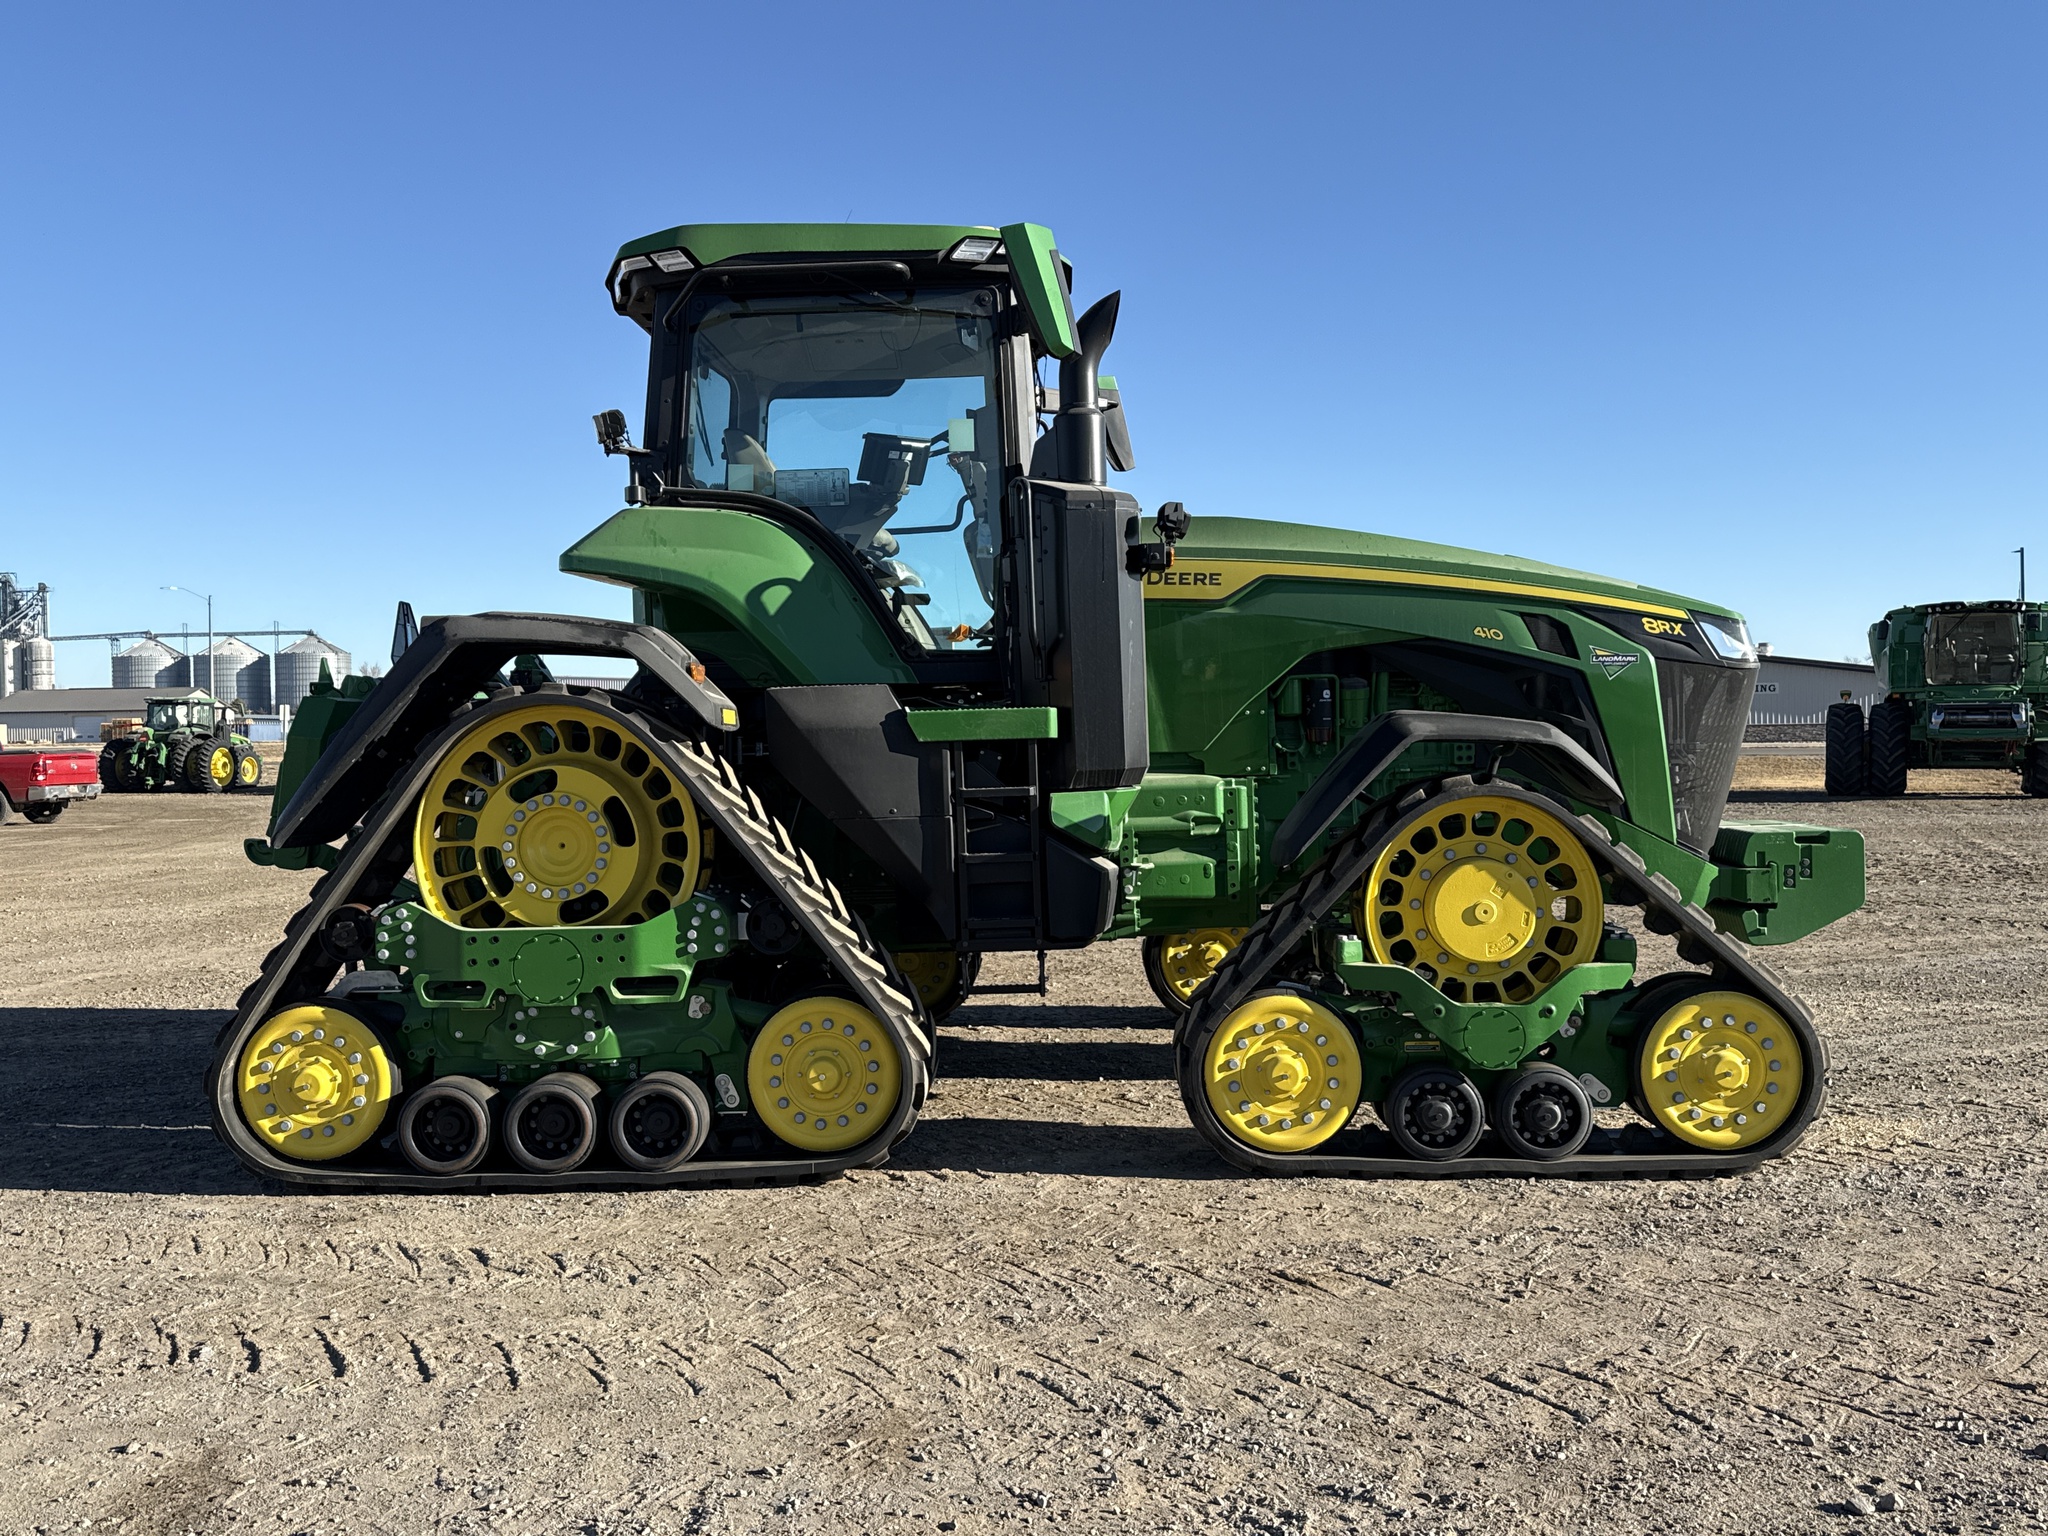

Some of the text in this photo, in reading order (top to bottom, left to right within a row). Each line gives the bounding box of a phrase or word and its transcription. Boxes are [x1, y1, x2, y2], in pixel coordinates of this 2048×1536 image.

[1146, 571, 1222, 586] DEERE
[1471, 626, 1504, 641] 410
[1641, 617, 1687, 637] 8RX
